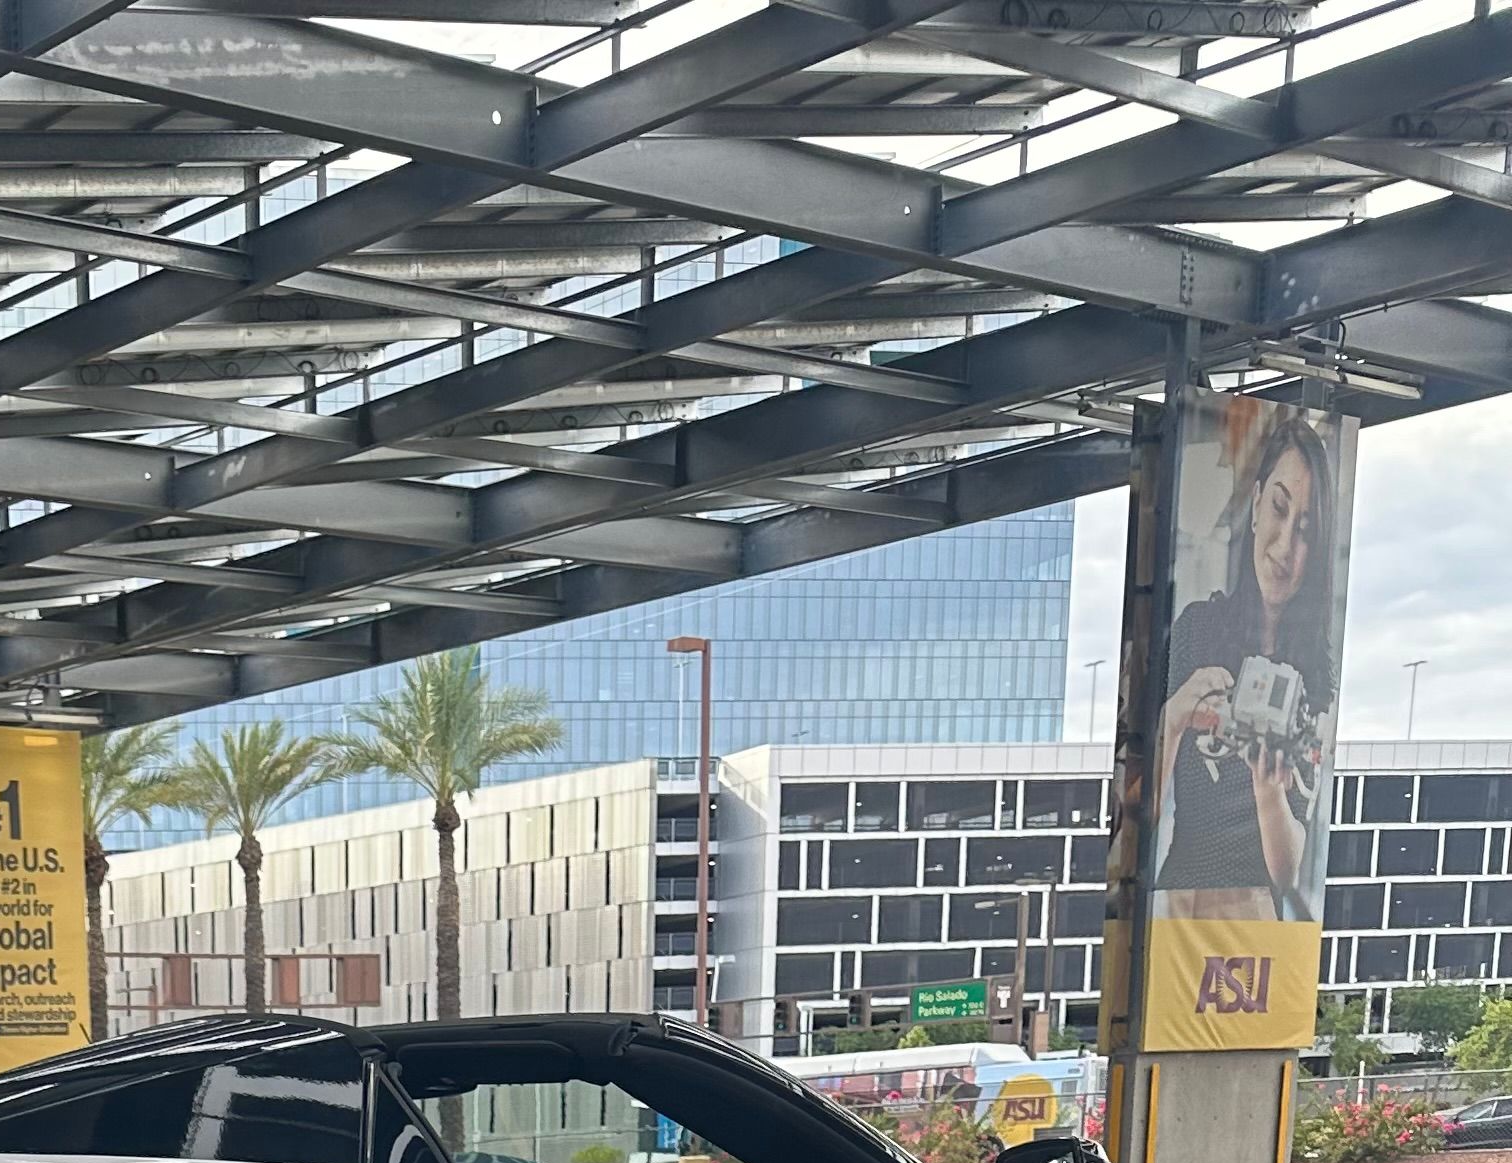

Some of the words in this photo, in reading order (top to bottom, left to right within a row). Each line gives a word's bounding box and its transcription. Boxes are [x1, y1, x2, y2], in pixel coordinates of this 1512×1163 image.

[22, 847, 65, 873] U.S.
[0, 878, 20, 895] #2
[22, 878, 37, 895] in
[33, 899, 54, 917] for
[1195, 956, 1271, 1013] ASU
[24, 993, 76, 1006] outreach
[935, 988, 968, 1003] Salado
[7, 1009, 77, 1022] stewardship
[918, 1005, 957, 1017] Parkway
[1003, 1096, 1045, 1121] ASU
